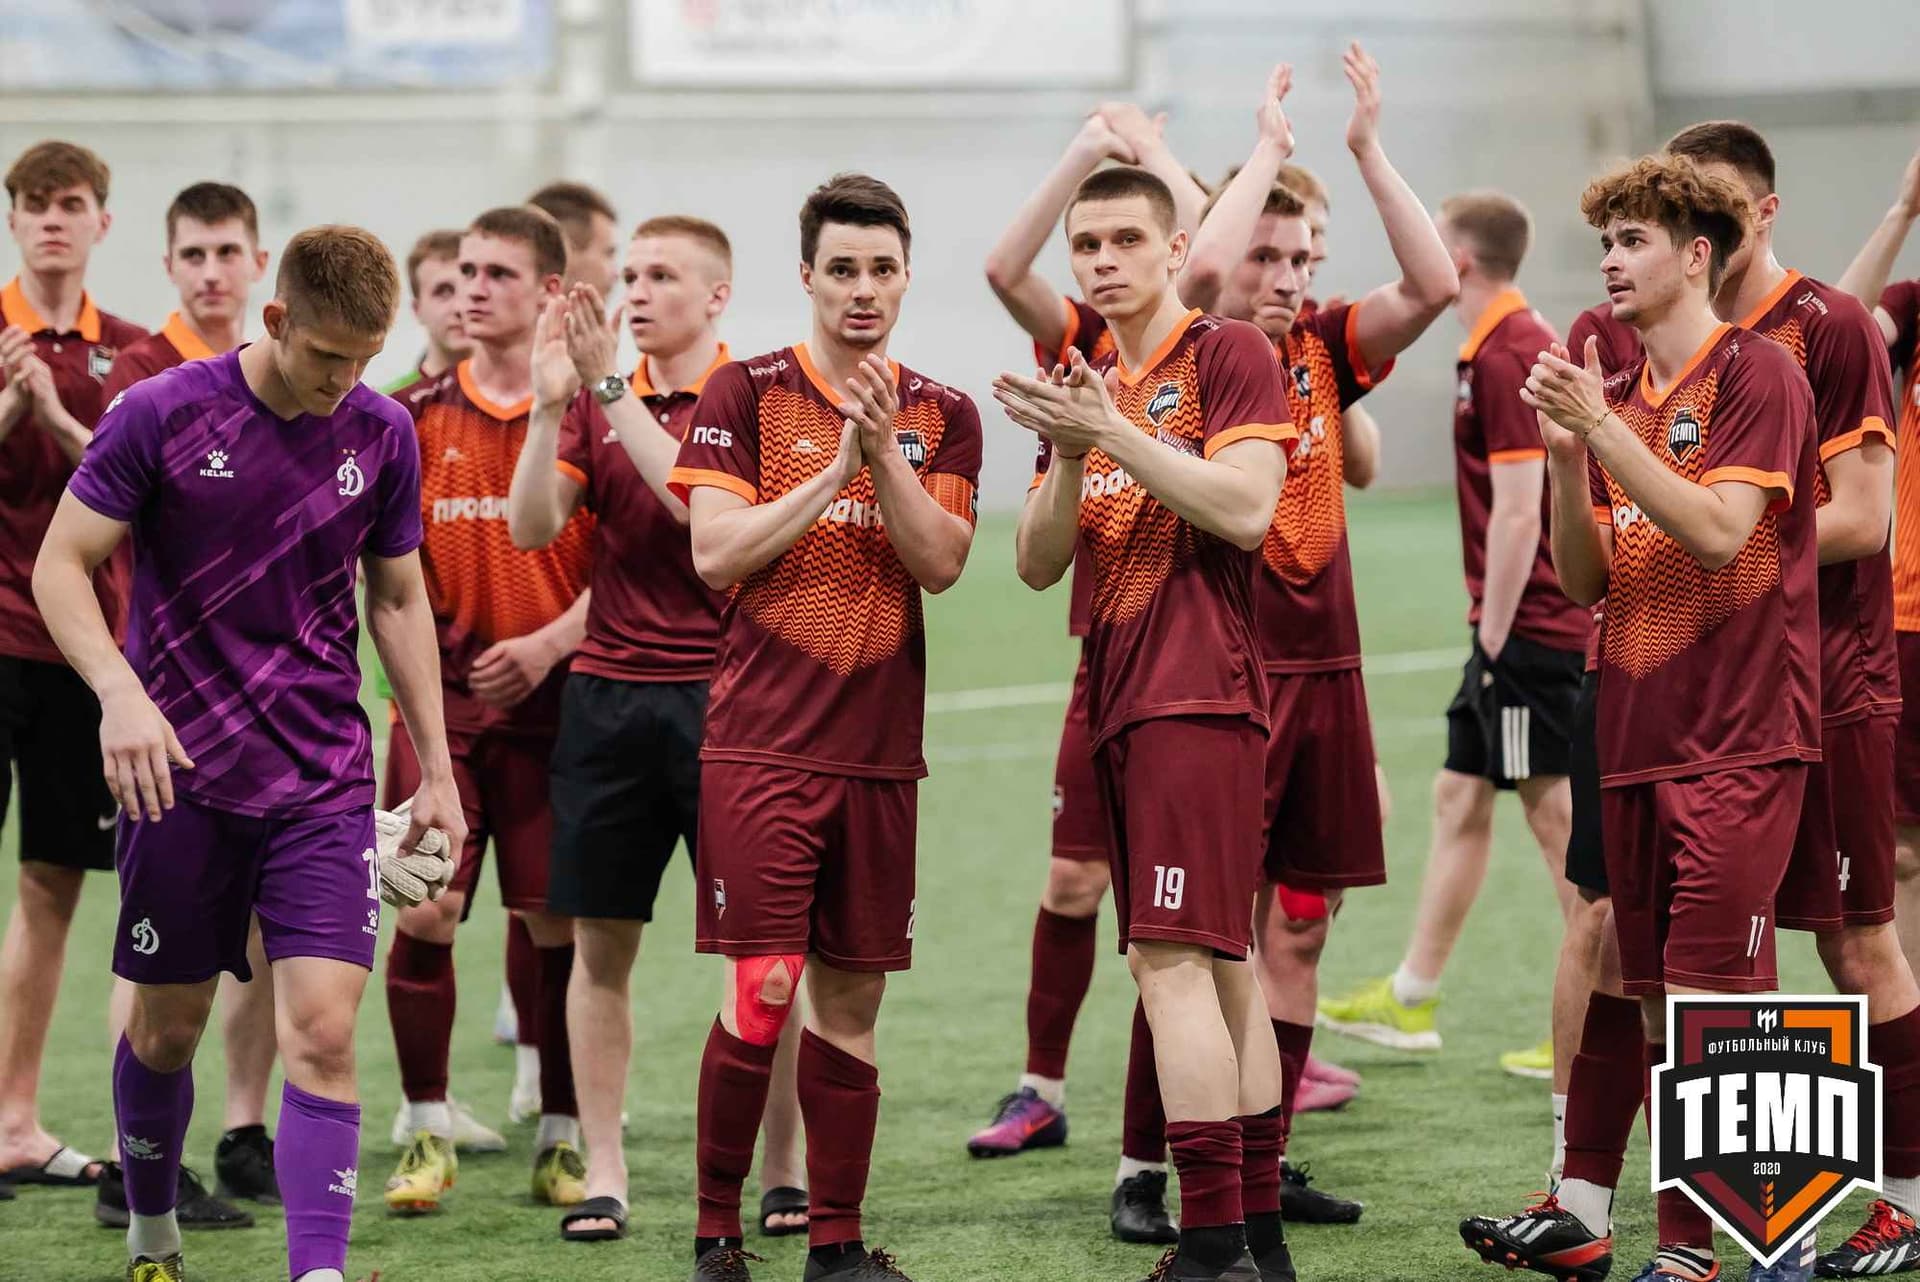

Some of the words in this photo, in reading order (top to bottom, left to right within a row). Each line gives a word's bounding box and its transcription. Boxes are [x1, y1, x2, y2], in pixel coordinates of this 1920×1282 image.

[692, 427, 733, 448] ПСБ
[1669, 422, 1699, 445] ТЕМП
[199, 468, 235, 478] KELME
[1153, 865, 1185, 910] 19
[1746, 915, 1766, 958] 11
